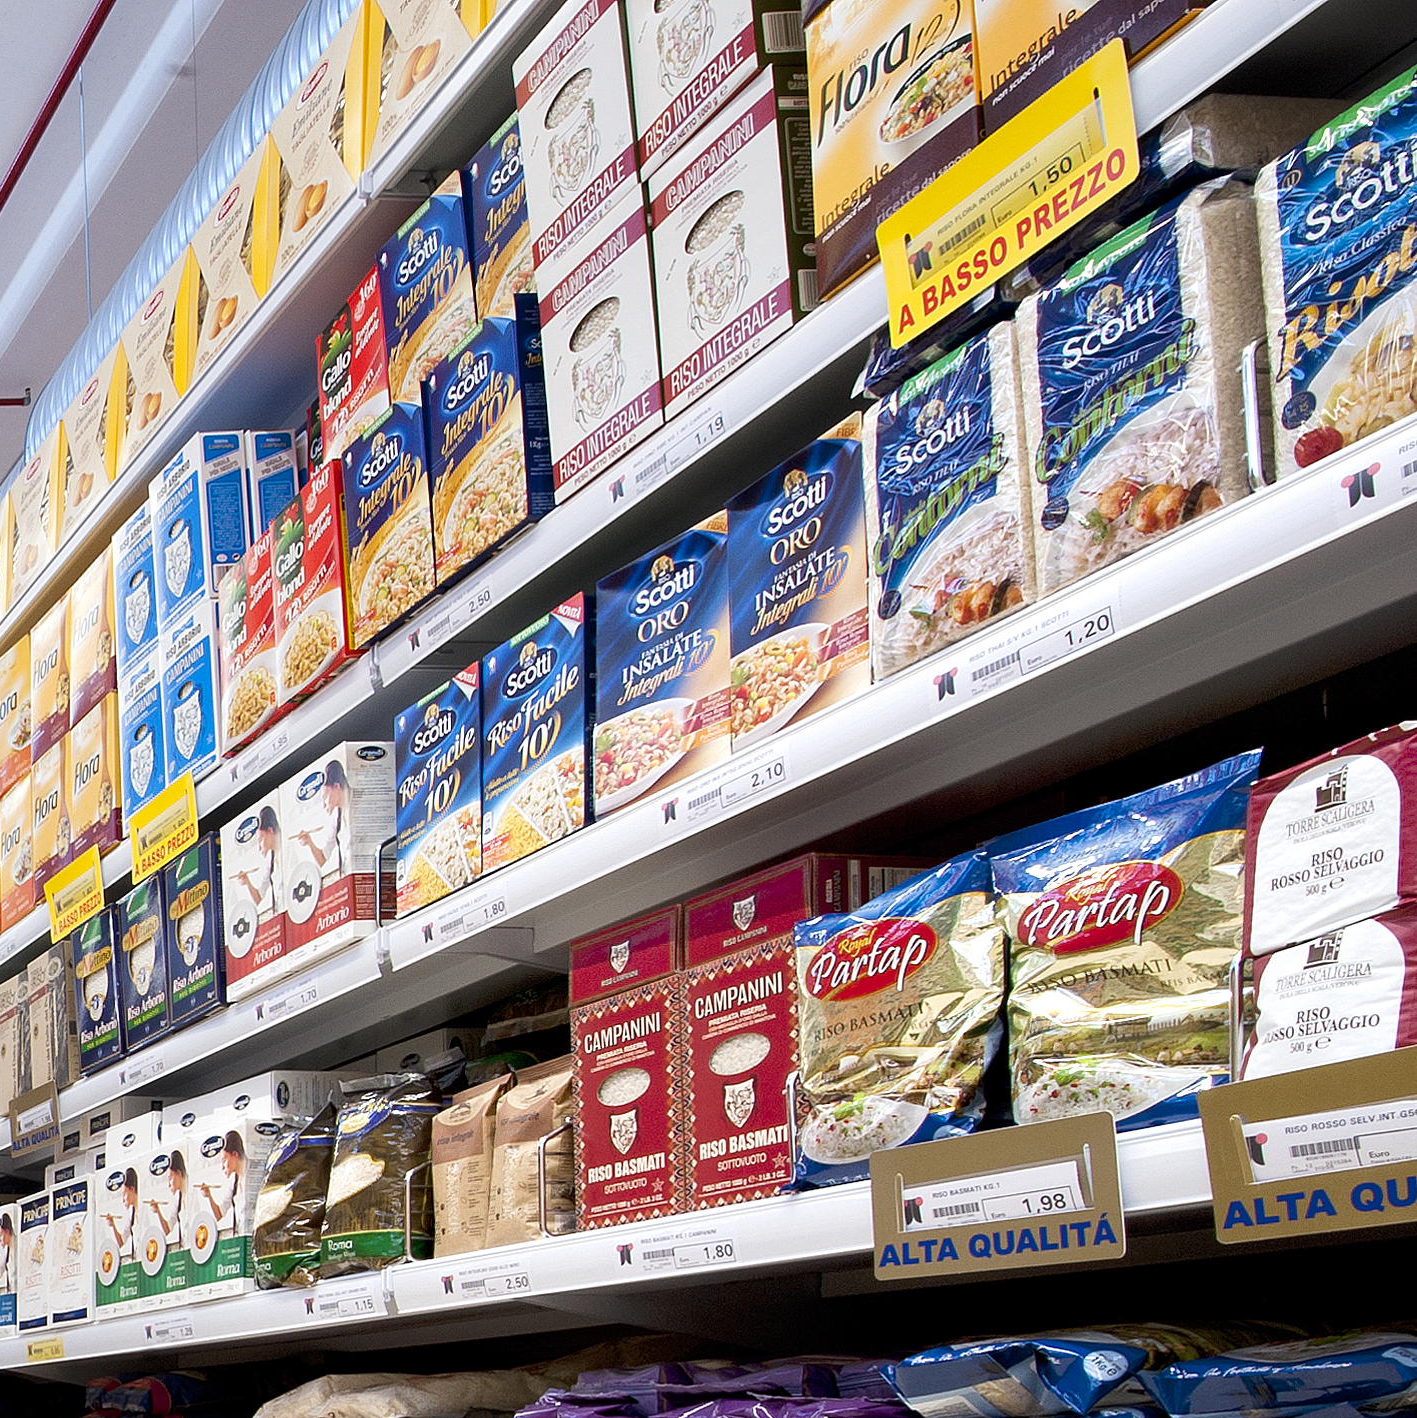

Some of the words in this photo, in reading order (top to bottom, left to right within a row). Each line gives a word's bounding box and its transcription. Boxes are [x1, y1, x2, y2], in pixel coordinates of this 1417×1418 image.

[644, 113, 672, 157] RISO
[674, 35, 745, 125] INTEGRALE
[816, 22, 912, 150] Flora
[1029, 156, 1073, 197] 1,50
[399, 231, 439, 285] Scotti
[898, 304, 915, 335] A
[921, 236, 1008, 317] BASSO
[1015, 148, 1125, 250] PREZZO
[670, 358, 702, 397] RISO
[703, 291, 779, 368] INTEGRALE
[1063, 290, 1155, 369] Scotti
[322, 350, 352, 391] Gallo
[1036, 318, 1200, 484] Contorni
[558, 449, 586, 484] RISO
[586, 392, 651, 458] INTEGRALE
[896, 406, 970, 476] Scotti
[768, 475, 827, 535] Scotti
[275, 541, 305, 577] Gallo
[770, 516, 822, 566] ORO
[635, 564, 695, 617] Scotti
[755, 546, 836, 613] INSALATE
[637, 601, 690, 643] ORO
[506, 648, 552, 697] Scotti
[622, 628, 703, 684] INSALATE
[414, 712, 452, 754] Scotti
[751, 762, 784, 788] 2,10
[1285, 817, 1320, 839] TORRE
[1321, 798, 1376, 826] SCALIGERA
[133, 861, 141, 878] A
[141, 842, 165, 874] BASSO
[167, 822, 196, 858] PREZZO
[1271, 869, 1310, 891] ROSSO
[1313, 849, 1385, 880] SELVAGGIO
[1311, 847, 1343, 867] RISO
[483, 900, 506, 920] 1,80
[252, 940, 283, 968] Arborio
[810, 934, 929, 996] Partap
[694, 971, 783, 1021] CAMPANINI
[1296, 1006, 1330, 1024] RISO
[584, 1011, 661, 1054] CAMPANINI
[1297, 1013, 1380, 1038] SELVAGGIO
[699, 1137, 727, 1161] RISO
[728, 1123, 789, 1154] BASMATI
[1369, 1148, 1391, 1160] Euro
[588, 1163, 613, 1184] RISO
[614, 1152, 665, 1179] BASMATI
[1022, 1193, 1068, 1215] 1,98
[1224, 1190, 1337, 1229] ALTA
[328, 1236, 355, 1253] Roma
[703, 1242, 734, 1260] 1,80
[880, 1238, 959, 1268] ALTA
[165, 1271, 187, 1289] Roma
[216, 1261, 241, 1279] Roma
[505, 1276, 529, 1290] 2,50
